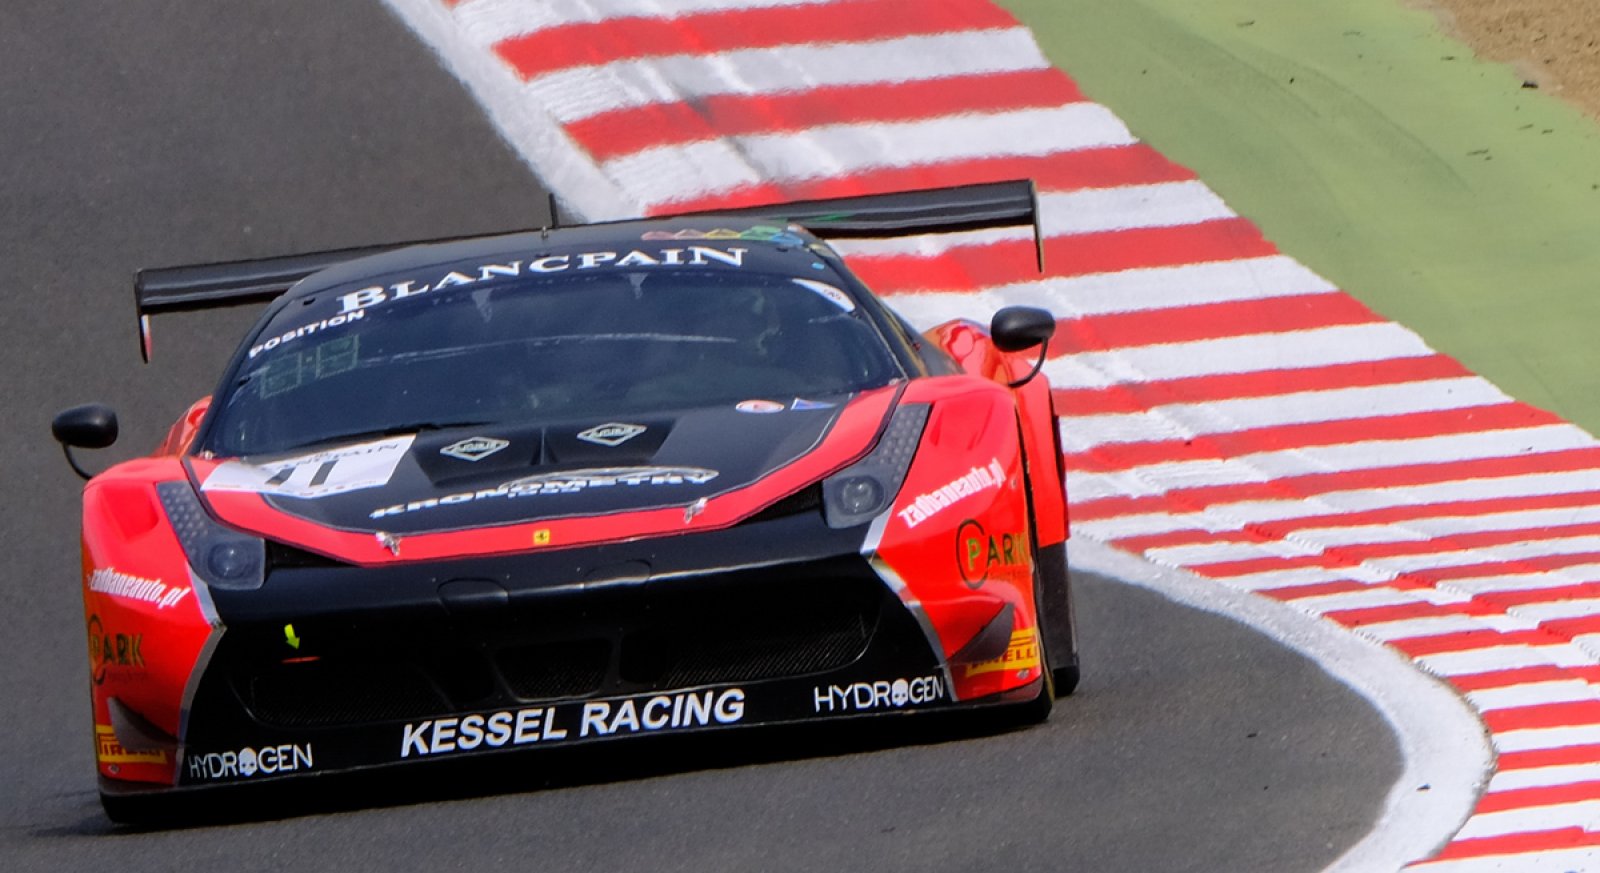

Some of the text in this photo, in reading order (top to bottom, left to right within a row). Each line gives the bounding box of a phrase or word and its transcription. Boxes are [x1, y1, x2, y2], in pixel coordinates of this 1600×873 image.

[336, 245, 748, 316] BLANCPAIN
[248, 308, 365, 359] POSITION
[369, 474, 717, 519] KRONOMETRY
[814, 672, 944, 712] HYDROGEN
[400, 688, 746, 758] KESSEL RACING
[187, 742, 313, 779] HYDROGEN
